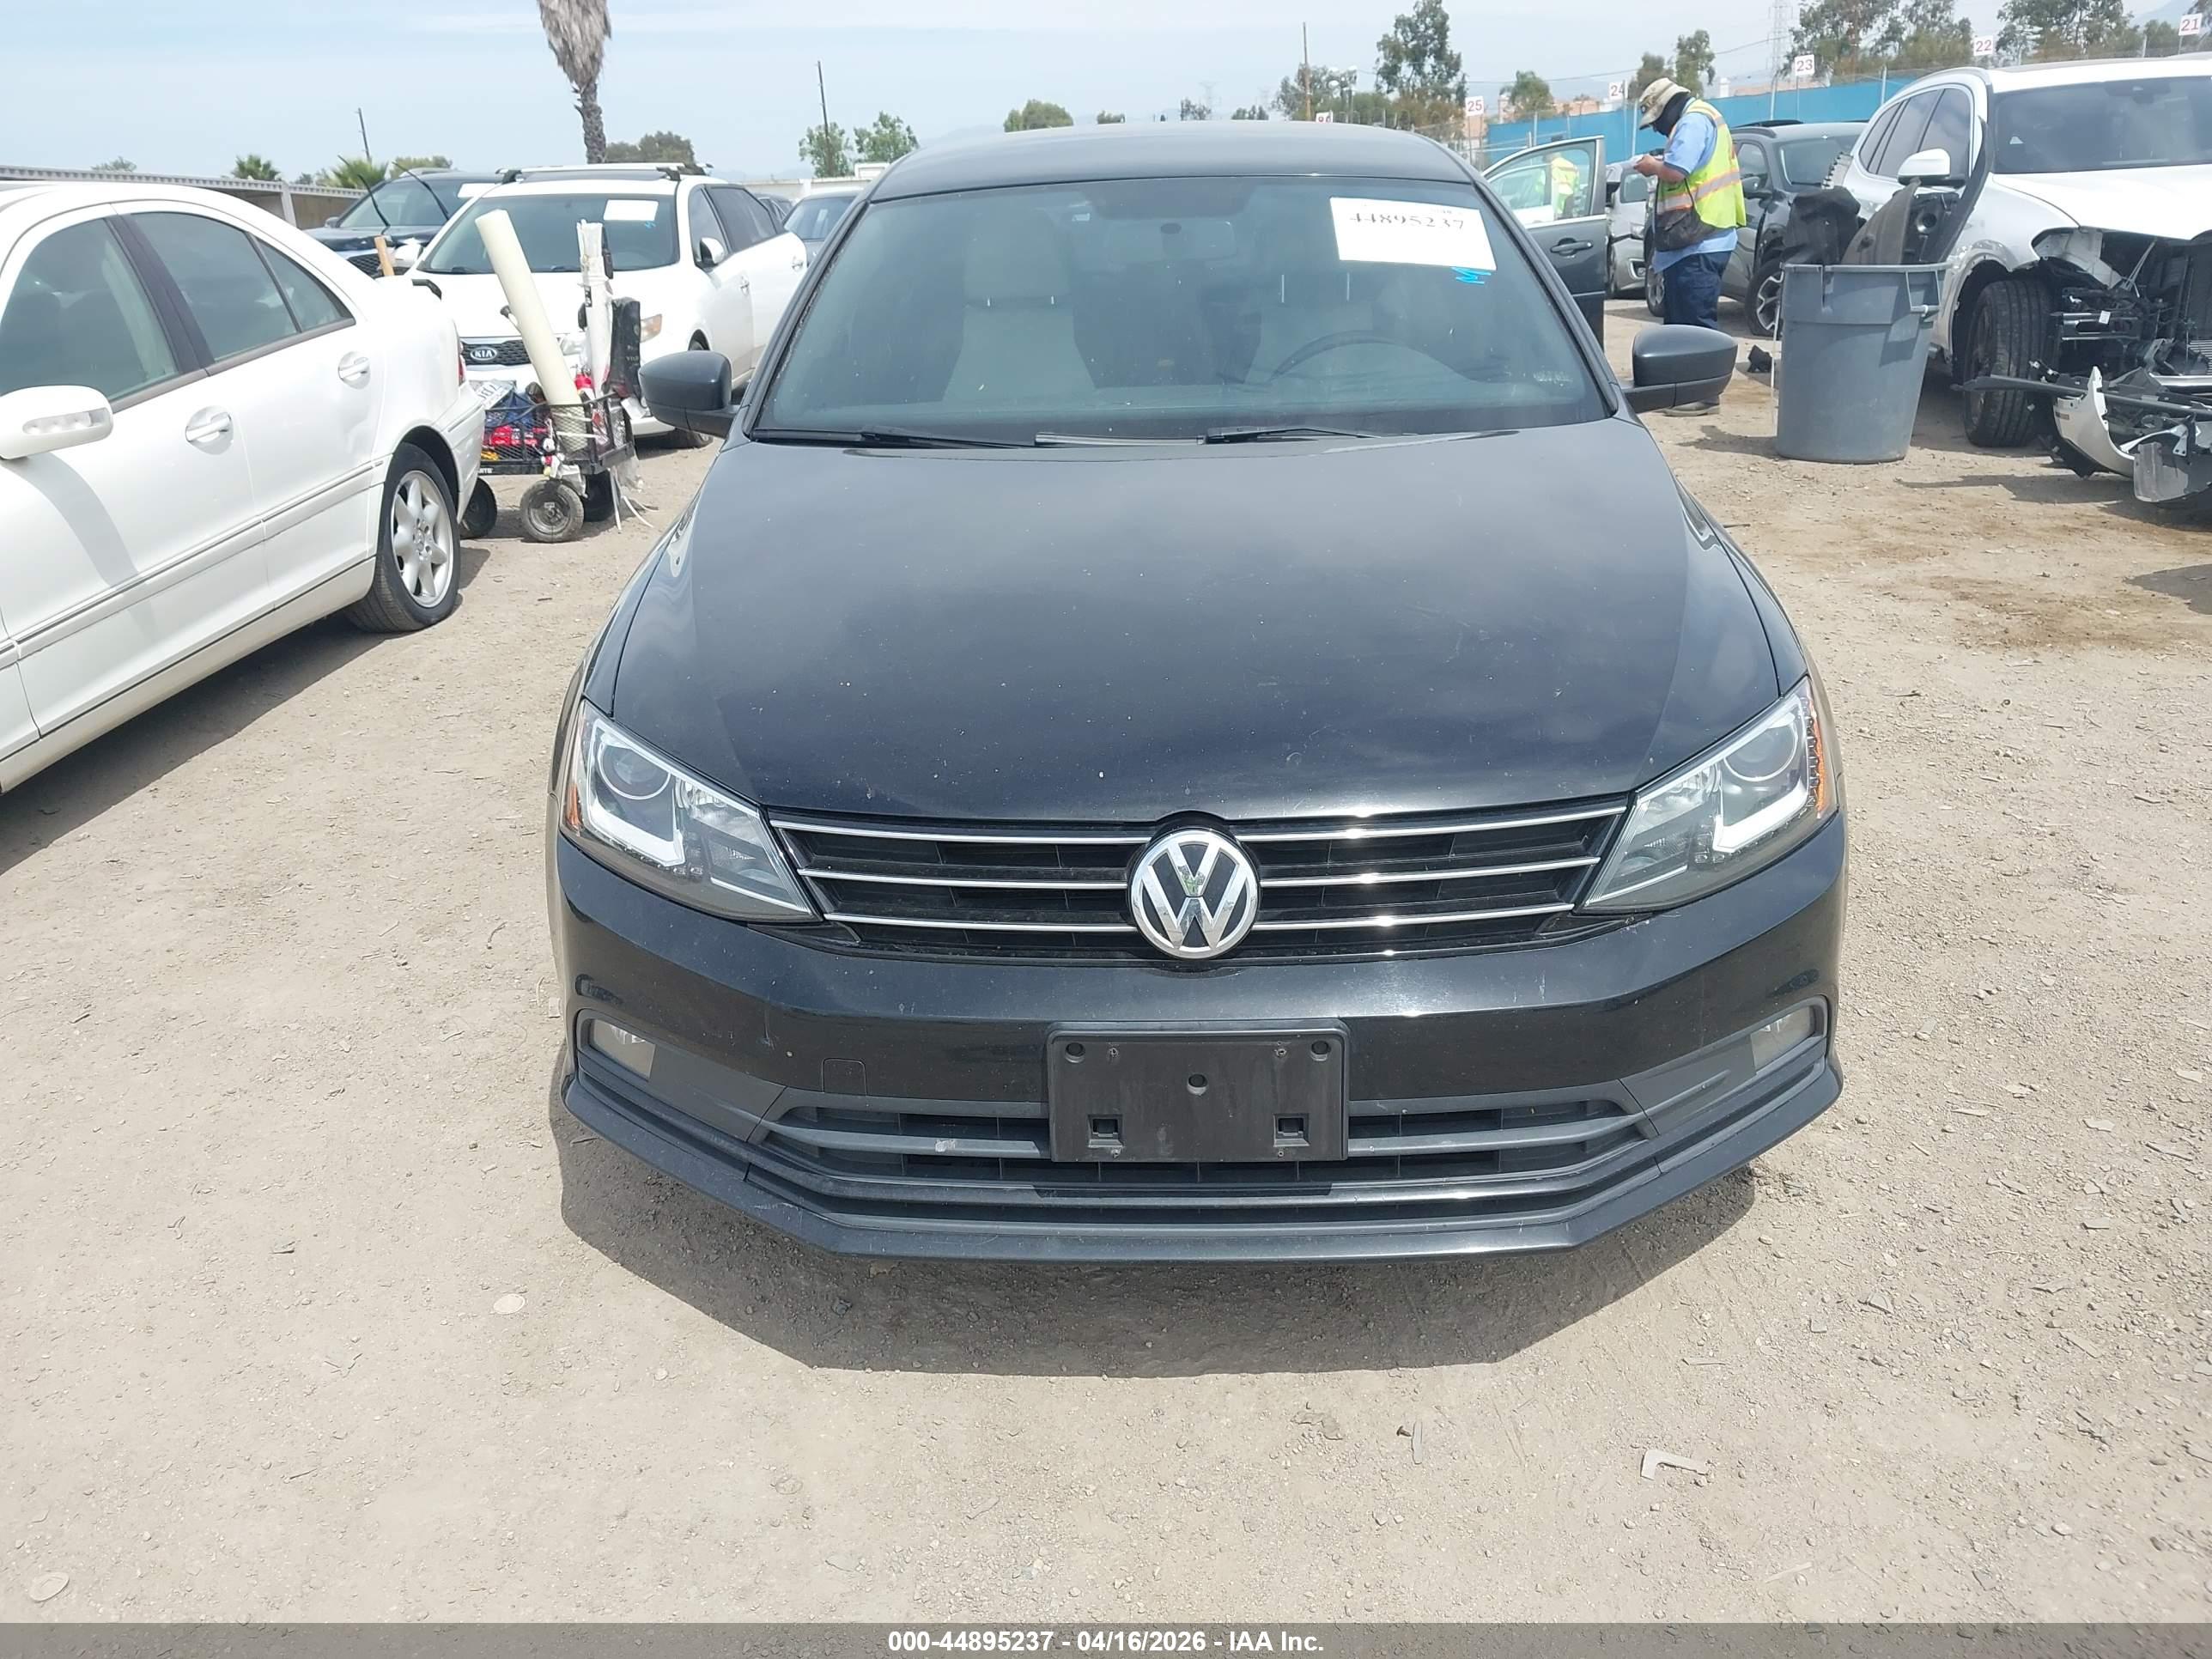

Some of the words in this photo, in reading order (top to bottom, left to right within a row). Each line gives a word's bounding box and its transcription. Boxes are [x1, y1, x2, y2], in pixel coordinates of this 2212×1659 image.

[2182, 19, 2199, 32] 21
[1975, 40, 1991, 52] 22
[1796, 59, 1813, 72] 23
[1468, 100, 1482, 112] 25
[474, 349, 493, 358] KIA
[1135, 835, 1252, 954] VW
